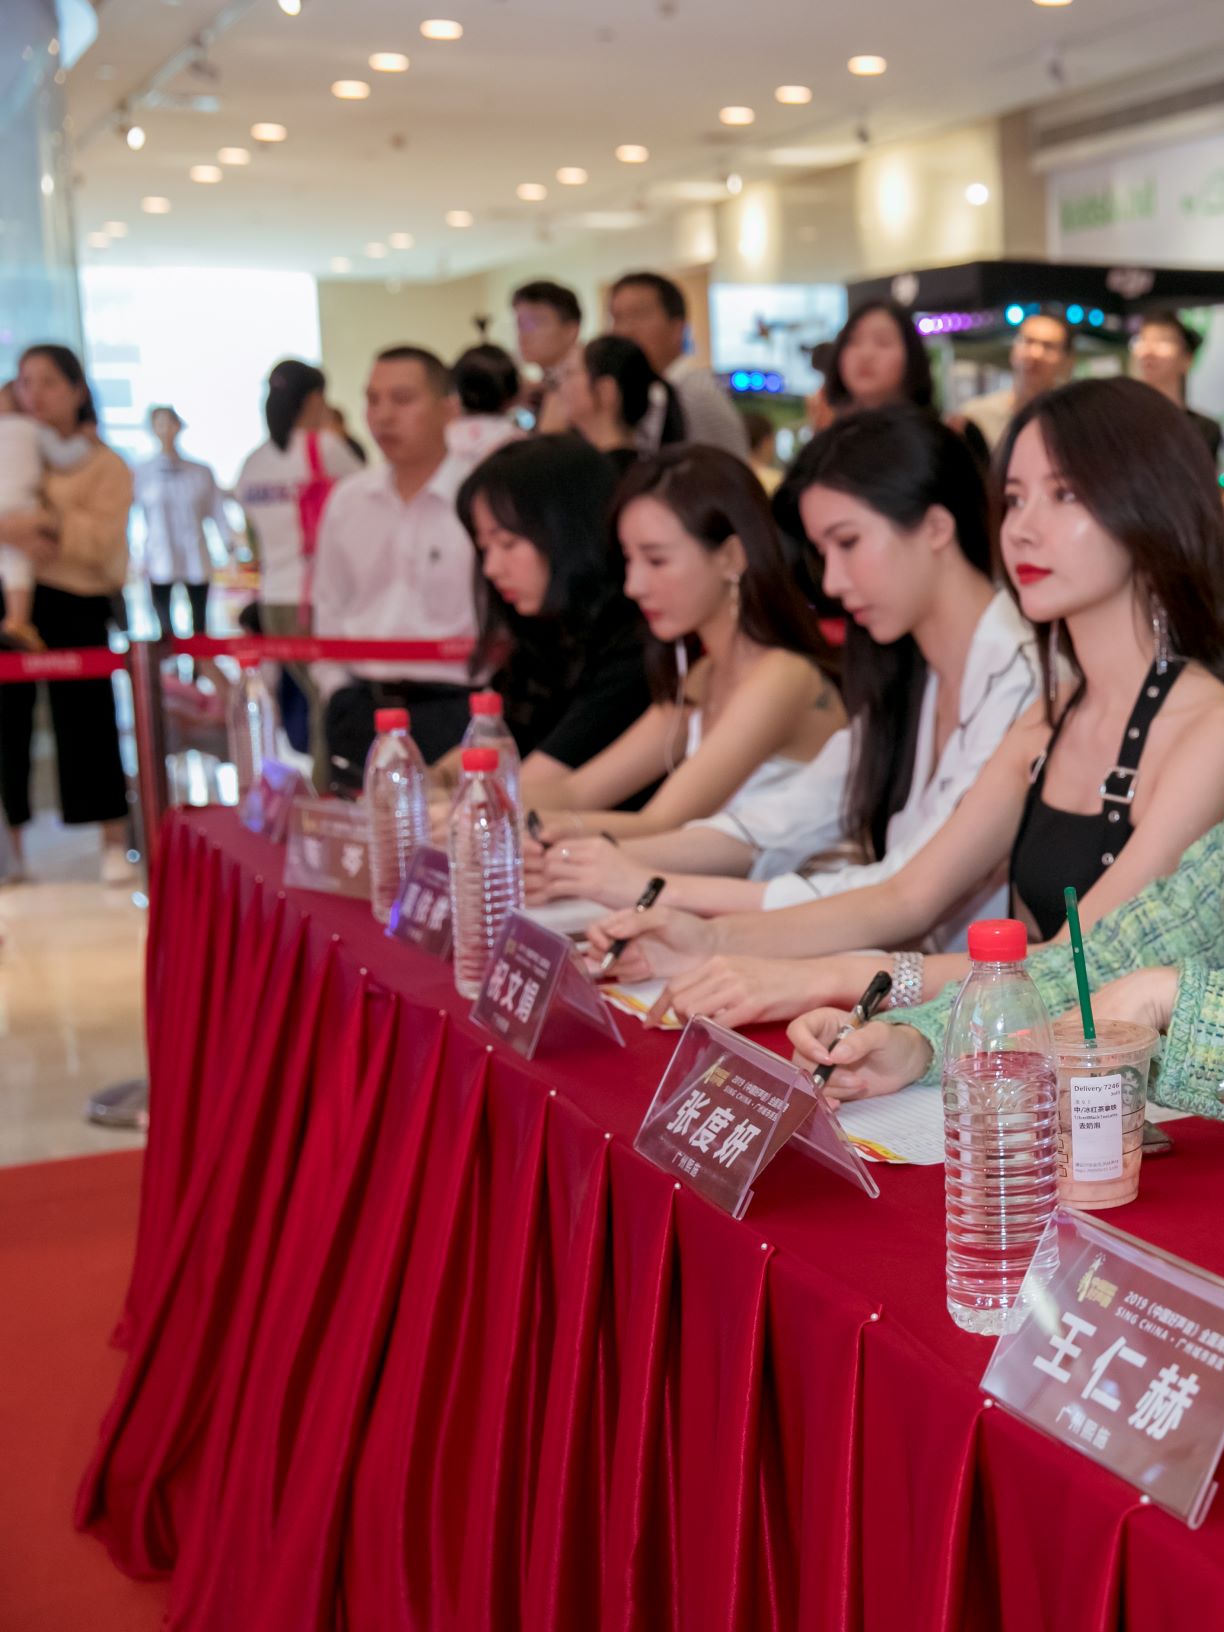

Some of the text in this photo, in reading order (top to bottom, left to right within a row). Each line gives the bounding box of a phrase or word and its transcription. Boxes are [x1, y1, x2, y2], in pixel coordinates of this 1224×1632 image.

[666, 1089, 762, 1169] 张度妍
[1115, 1306, 1139, 1325] SING
[1138, 1318, 1169, 1341] CHINA
[1124, 1291, 1149, 1311] 2019
[1032, 1311, 1201, 1442] 王仁赫
